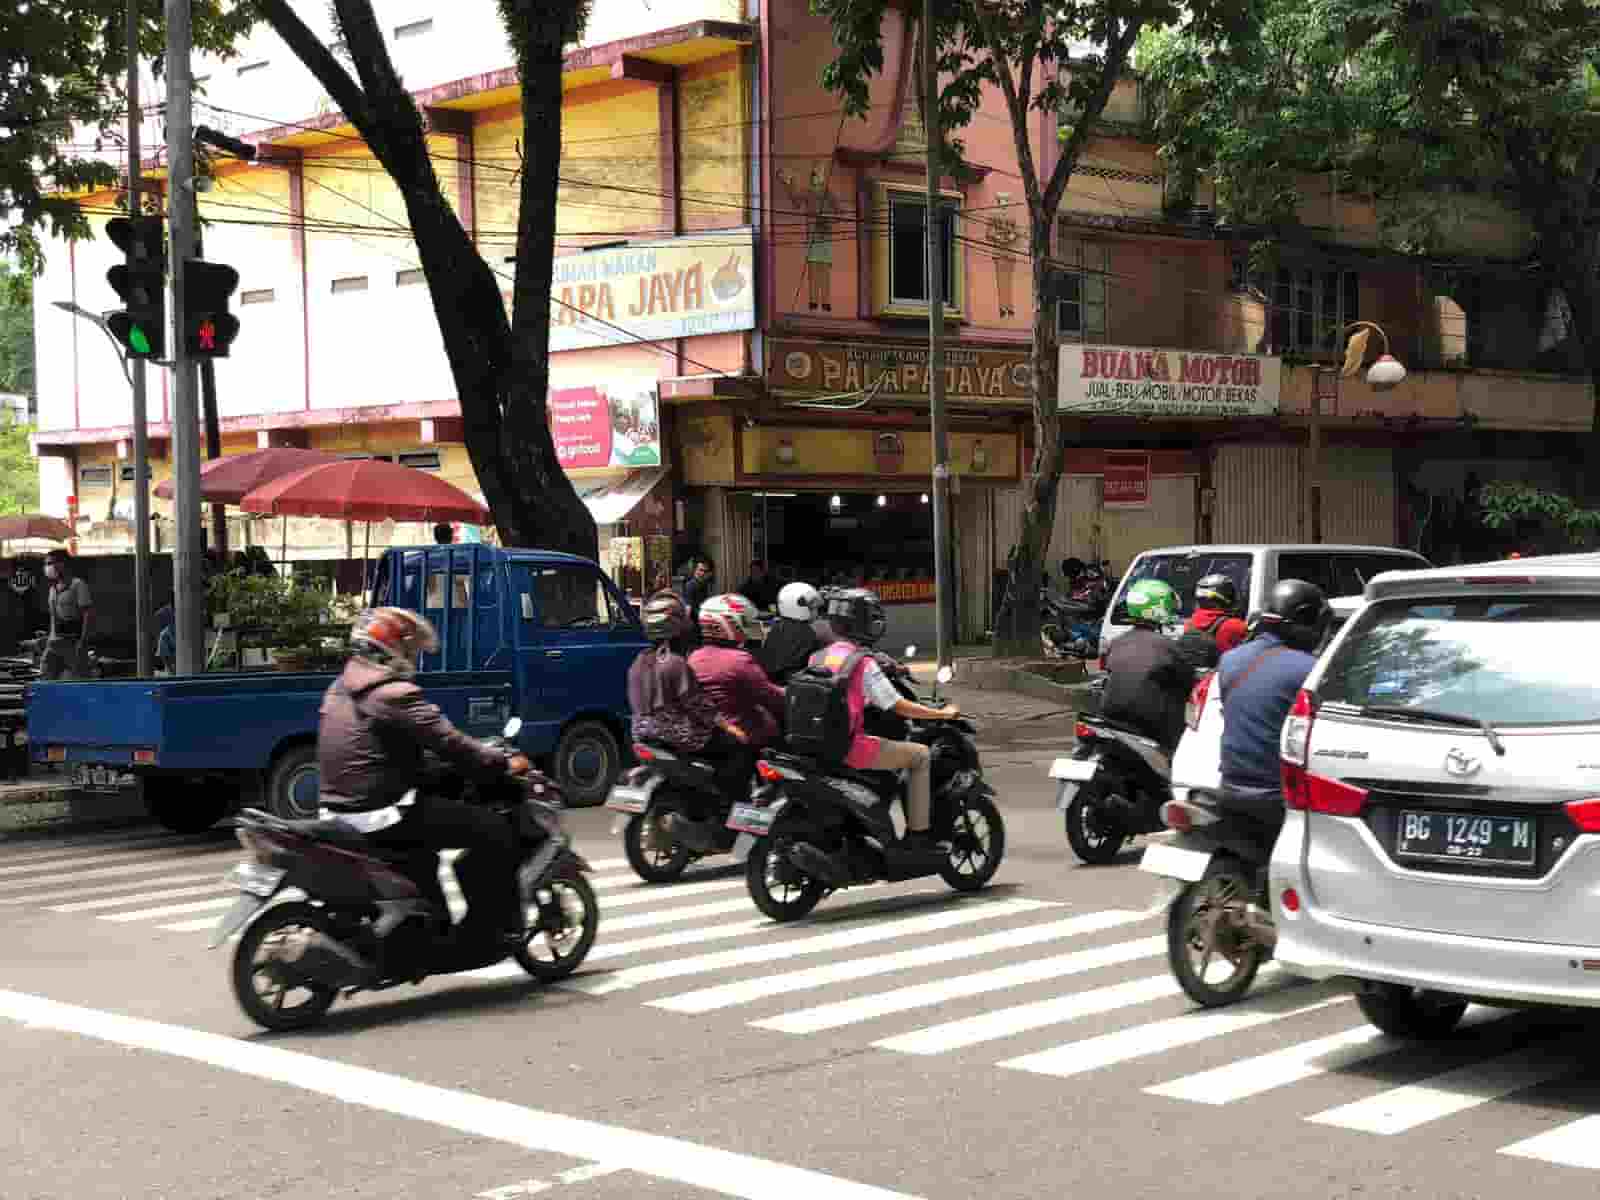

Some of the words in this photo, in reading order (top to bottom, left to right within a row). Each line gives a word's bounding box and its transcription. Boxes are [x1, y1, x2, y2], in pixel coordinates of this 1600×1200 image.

[553, 282, 614, 326] APA
[627, 262, 705, 317] JAYA
[944, 361, 1010, 397] JAYA
[1081, 351, 1169, 382] BUANA
[1182, 355, 1261, 386] MOTOR
[1405, 814, 1431, 840] BG
[1447, 817, 1493, 845] 1249
